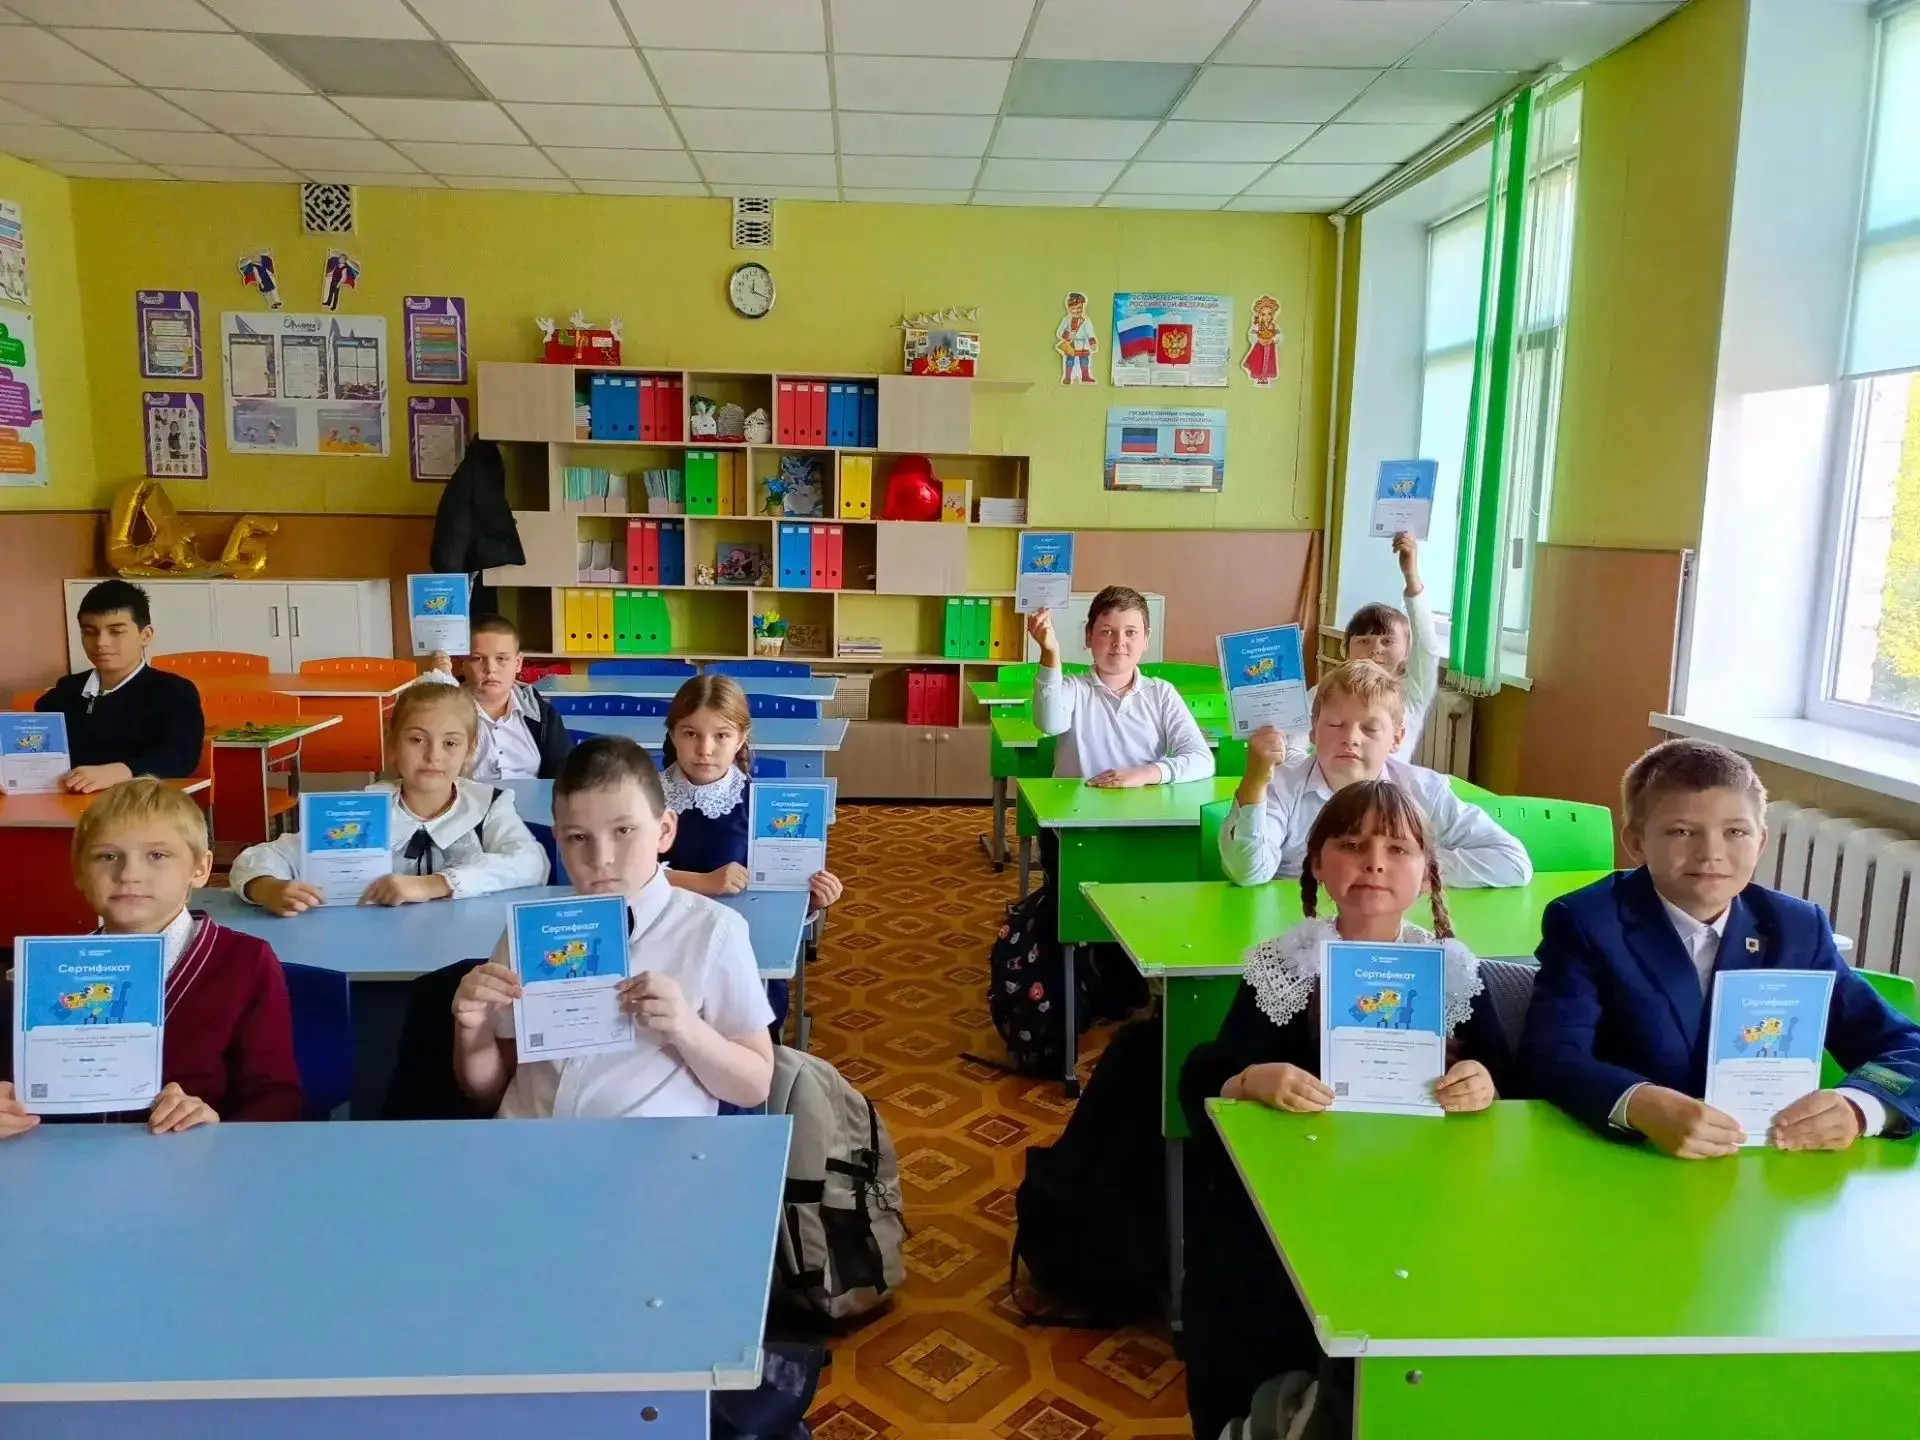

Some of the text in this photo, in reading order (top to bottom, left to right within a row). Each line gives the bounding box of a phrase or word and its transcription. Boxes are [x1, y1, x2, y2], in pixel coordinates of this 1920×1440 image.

[541, 922, 600, 935] Сертификат
[58, 963, 131, 975] Сертификат
[1354, 968, 1416, 981] Сертификат
